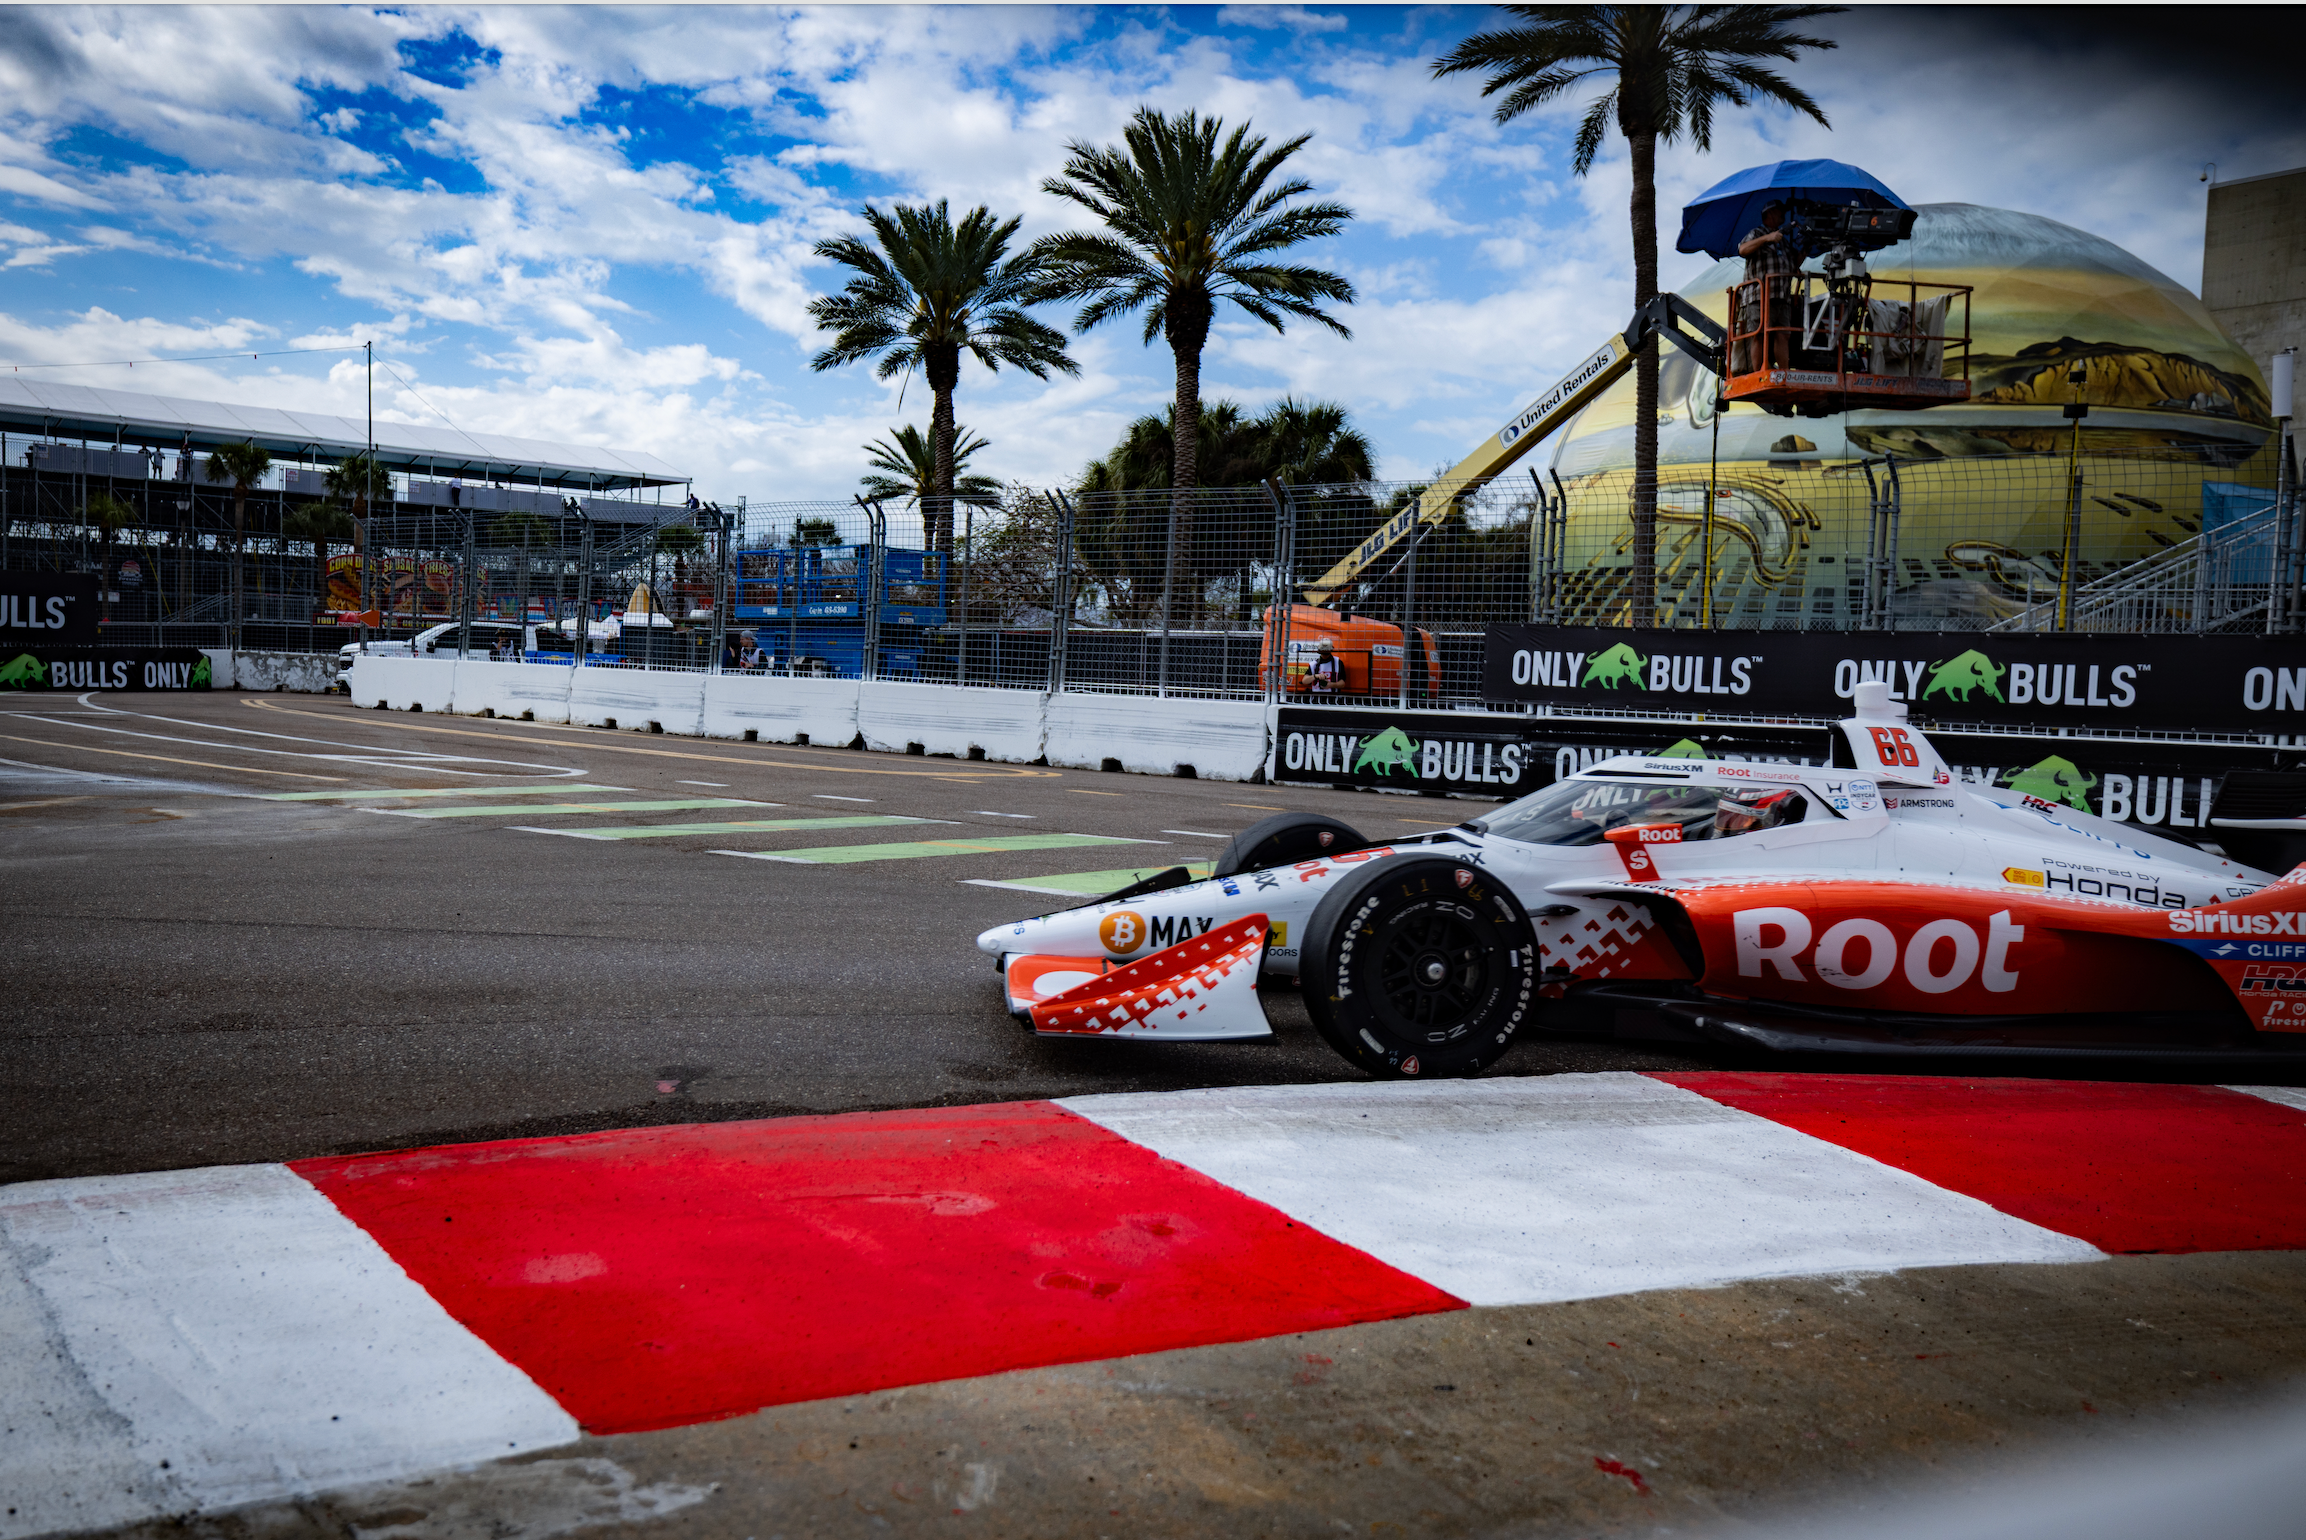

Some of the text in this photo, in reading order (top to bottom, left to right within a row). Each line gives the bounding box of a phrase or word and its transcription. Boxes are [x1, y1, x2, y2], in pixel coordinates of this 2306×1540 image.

[1520, 354, 1609, 429] United Rentals
[1358, 503, 1418, 567] JLG LIF
[144, 661, 192, 689] ONLY
[1511, 649, 1585, 687] ONLY
[1834, 659, 1926, 700] ONLY
[1285, 731, 1357, 773] ONLY
[1865, 726, 1920, 767] 66
[1643, 762, 1703, 773] SiriusXM
[1717, 766, 1800, 781] Root Insurance
[1900, 799, 1955, 808] ARMSTRONG
[1638, 828, 1682, 842] Root
[2042, 857, 2160, 884] Powered by
[2046, 869, 2186, 910] Honda
[1337, 896, 1381, 1000] Firestone
[1732, 906, 2025, 994] Root
[1495, 943, 1534, 1044] Firestone
[2239, 990, 2279, 998] Honda
